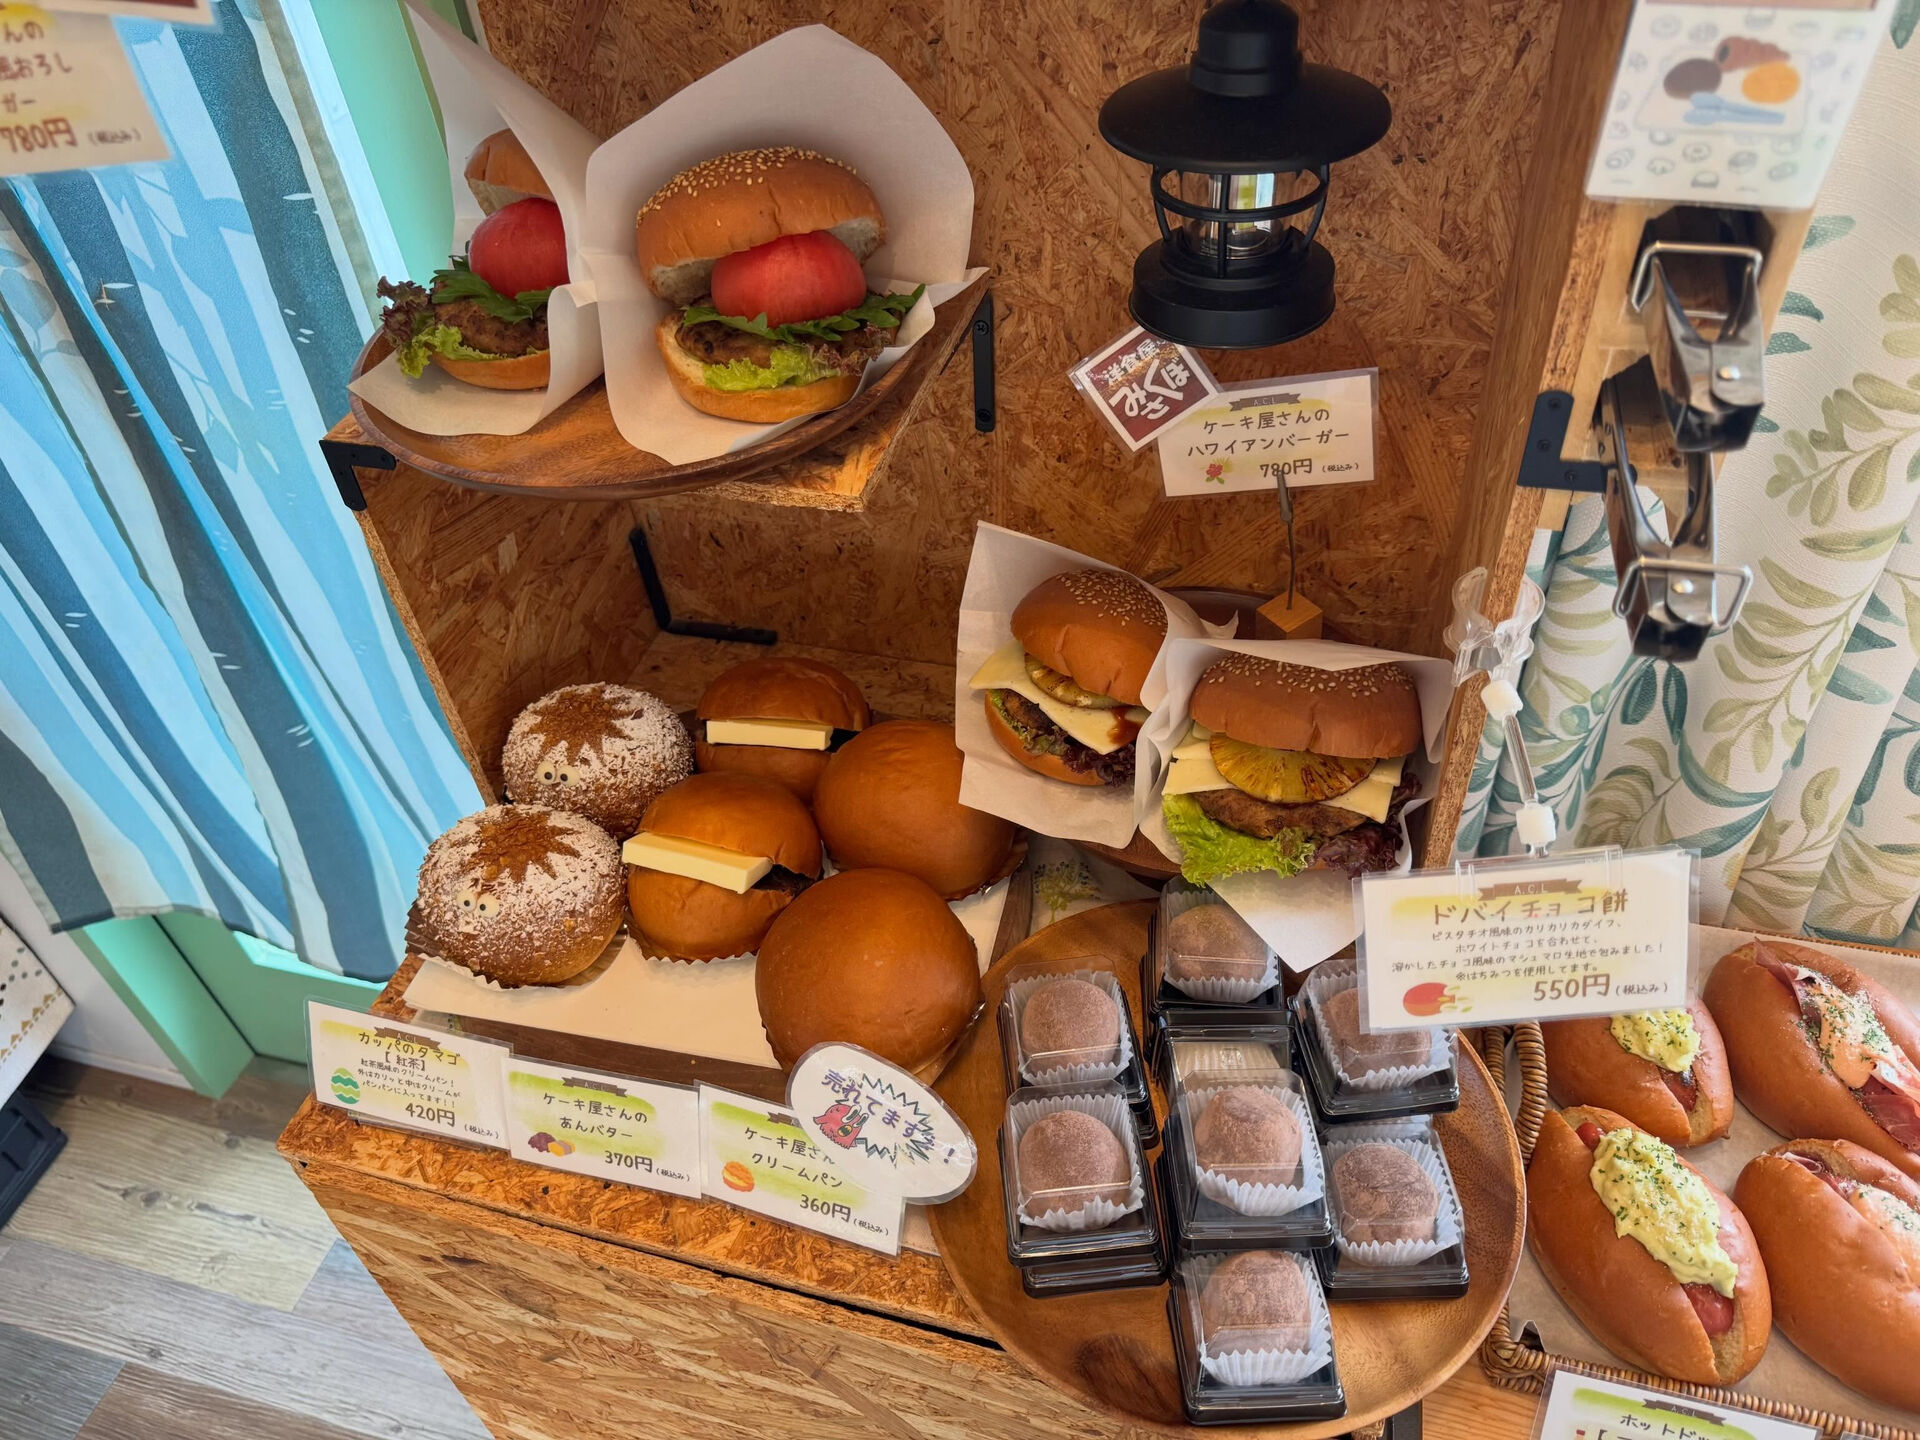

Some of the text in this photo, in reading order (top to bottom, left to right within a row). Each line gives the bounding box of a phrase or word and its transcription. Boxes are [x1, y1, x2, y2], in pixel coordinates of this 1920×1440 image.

[0, 117, 77, 152] 780円
[1203, 408, 1330, 434] ケーキ屋さんの
[1187, 429, 1349, 458] ハワイアンバーガー
[1259, 458, 1313, 478] 780円
[1514, 883, 1548, 895] A.C.L
[1434, 888, 1628, 925] ドバイチョコ餅
[1533, 973, 1611, 1001] 550円
[359, 1032, 461, 1066] カッパのタマゴ
[405, 1102, 455, 1127] 420円
[543, 1092, 648, 1123] ケーキ屋さんの
[559, 1116, 633, 1138] あんバター
[604, 1150, 652, 1173] 370円
[751, 1153, 843, 1188] クリームパン
[799, 1194, 851, 1222] 360円
